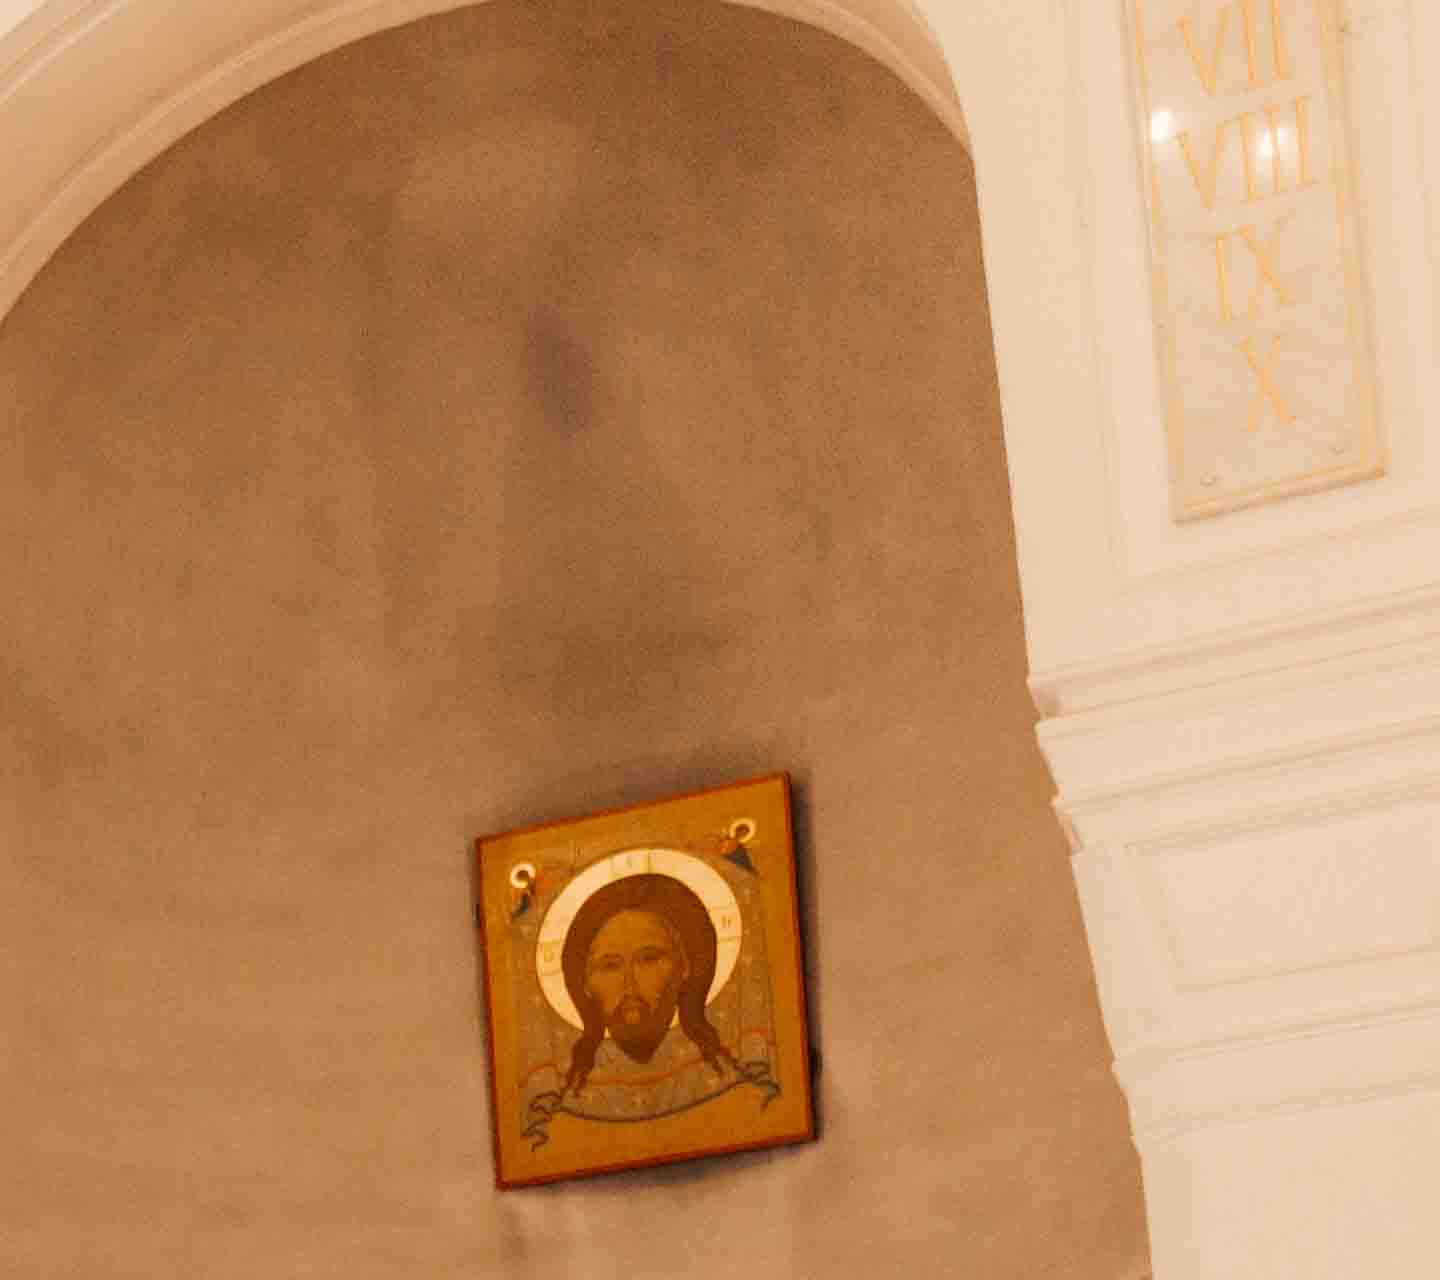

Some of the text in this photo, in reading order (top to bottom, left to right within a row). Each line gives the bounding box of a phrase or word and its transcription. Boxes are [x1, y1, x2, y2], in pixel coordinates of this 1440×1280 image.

[1176, 0, 1291, 96] VII
[1175, 95, 1318, 209] VIII
[1210, 217, 1293, 325] IX
[1235, 334, 1297, 433] X
